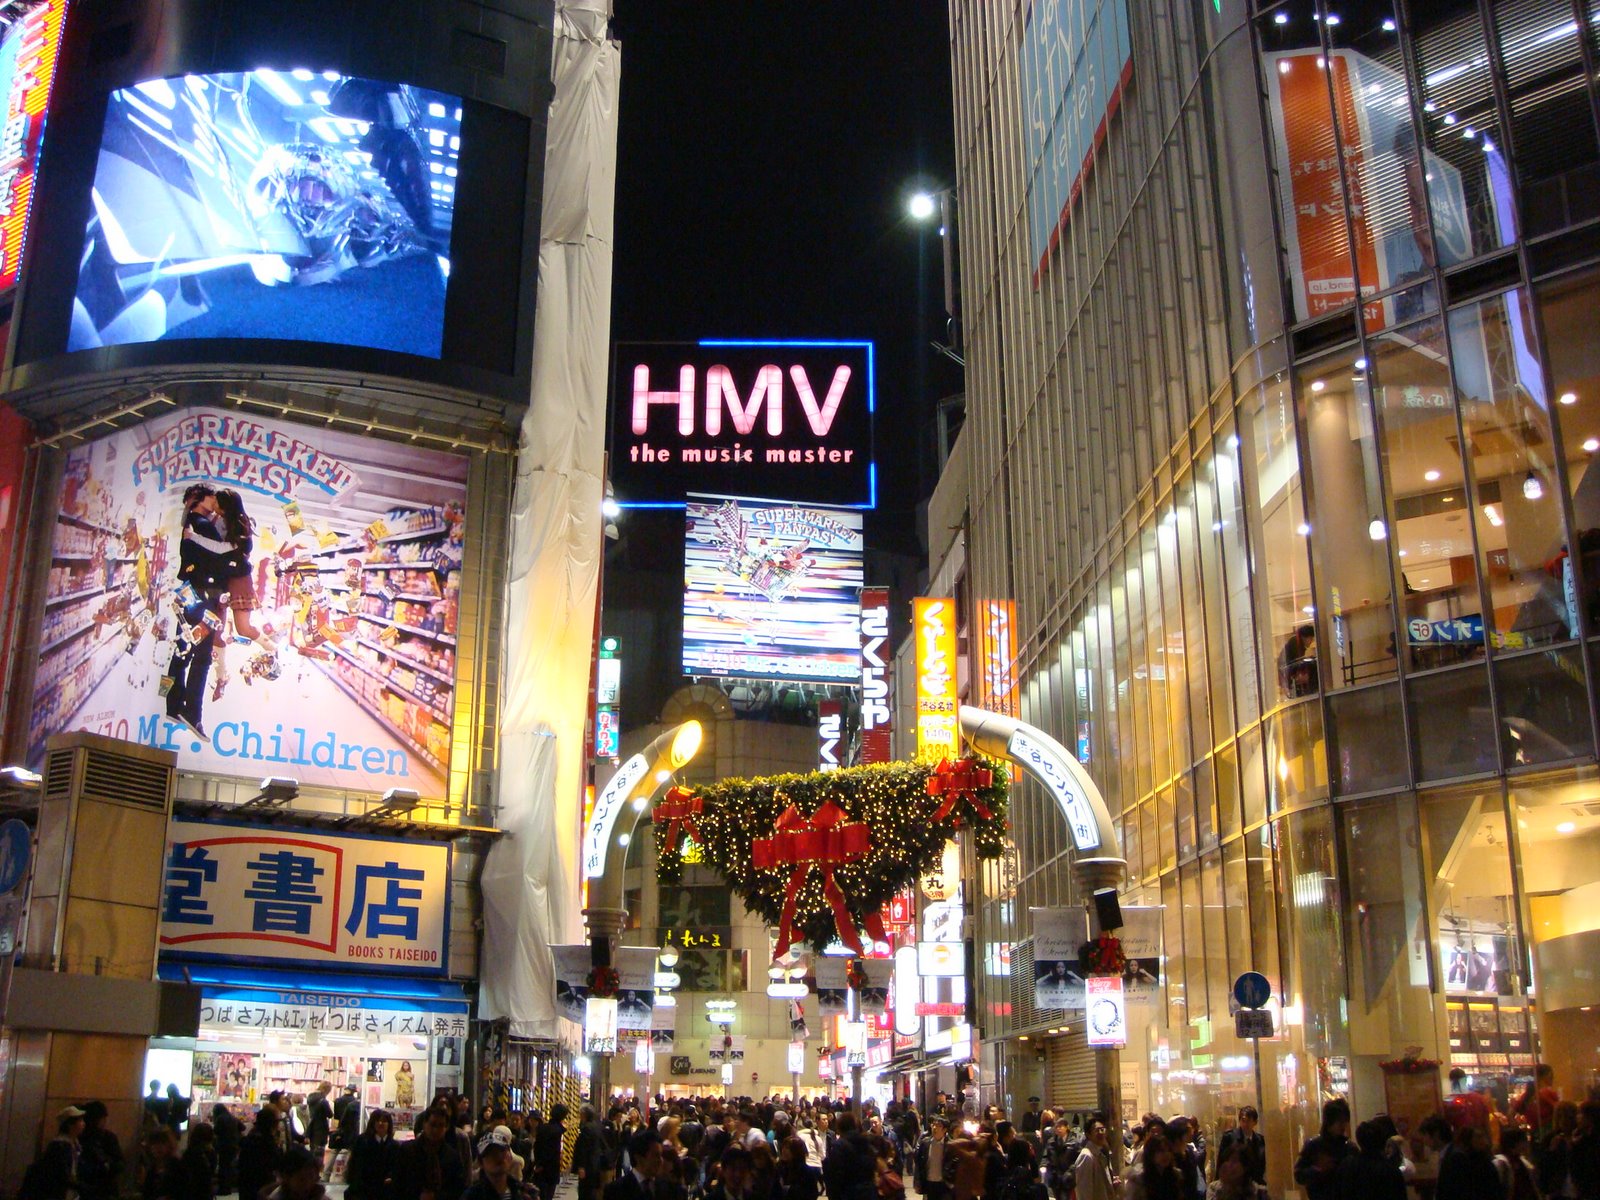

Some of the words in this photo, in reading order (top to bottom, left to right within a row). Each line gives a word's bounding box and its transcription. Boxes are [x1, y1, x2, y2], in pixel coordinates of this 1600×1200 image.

[632, 364, 852, 437] HMV
[134, 414, 357, 494] SUPERMARKET
[159, 447, 302, 501] FANTASY
[630, 444, 670, 463] the
[682, 443, 753, 463] music
[766, 446, 853, 463] master
[753, 507, 858, 542] SUPERMARKET
[772, 522, 836, 546] FANTASY
[862, 605, 890, 730] さくらや
[138, 714, 409, 777] Mr.Children
[348, 945, 384, 959] BOOKS
[388, 947, 438, 963] TAISEIDO
[277, 992, 361, 1008] TAISEIDO
